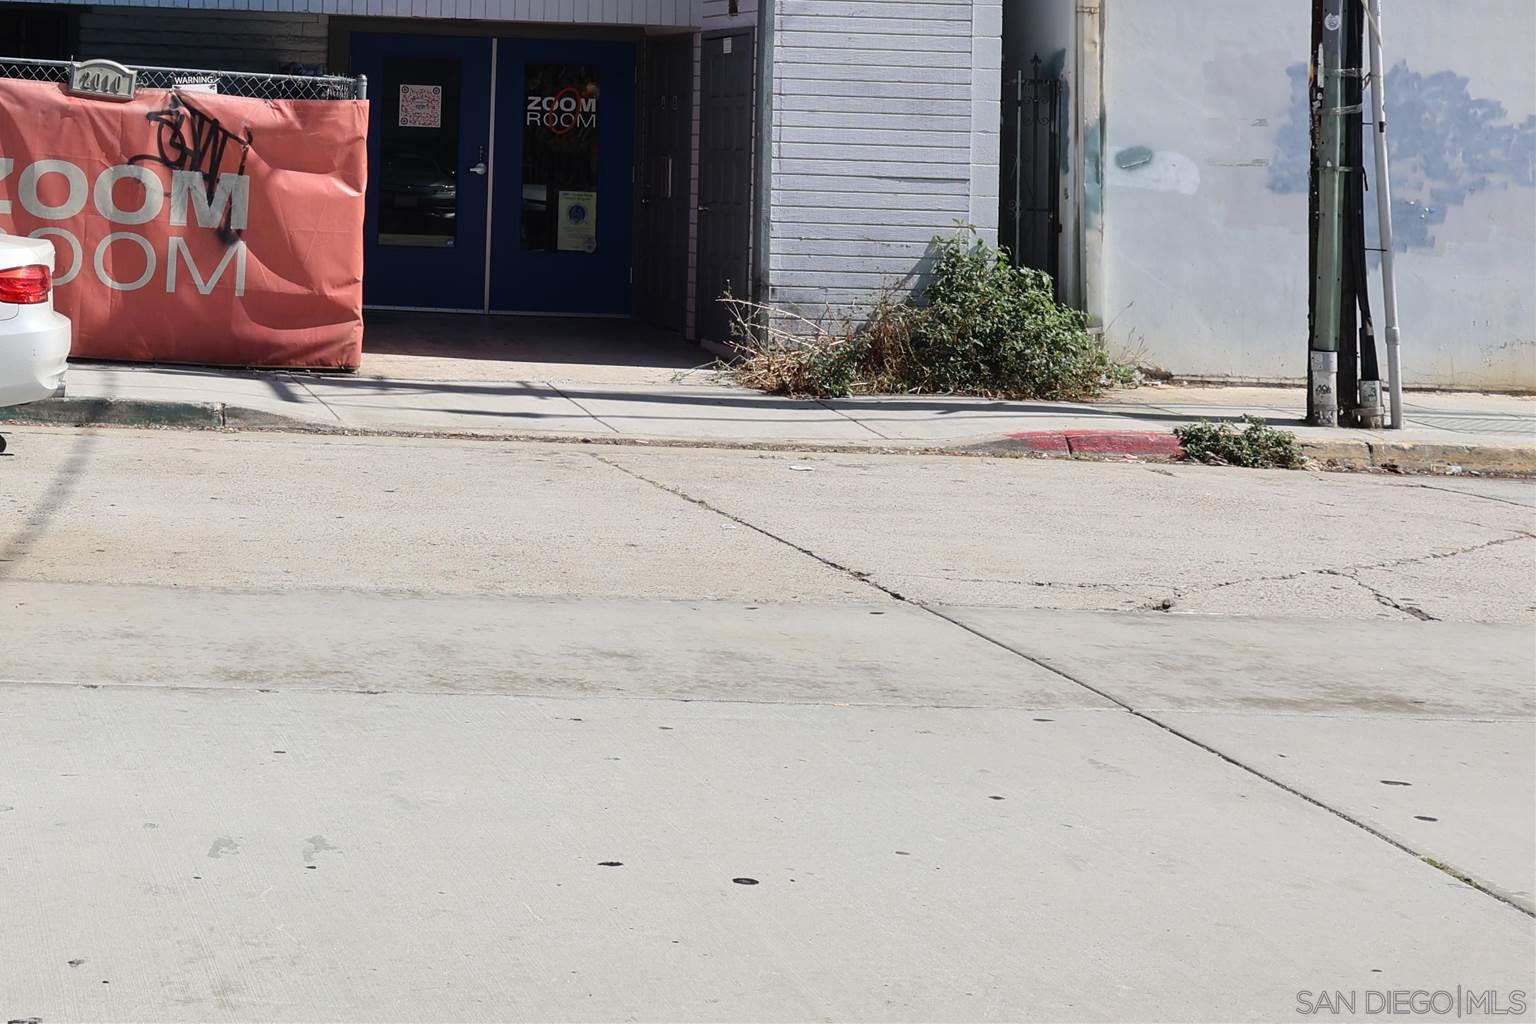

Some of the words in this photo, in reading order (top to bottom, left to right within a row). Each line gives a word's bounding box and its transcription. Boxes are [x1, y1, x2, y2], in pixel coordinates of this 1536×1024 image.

[173, 76, 214, 85] WARNING
[526, 96, 597, 113] ZOOM
[526, 111, 597, 129] ROOM
